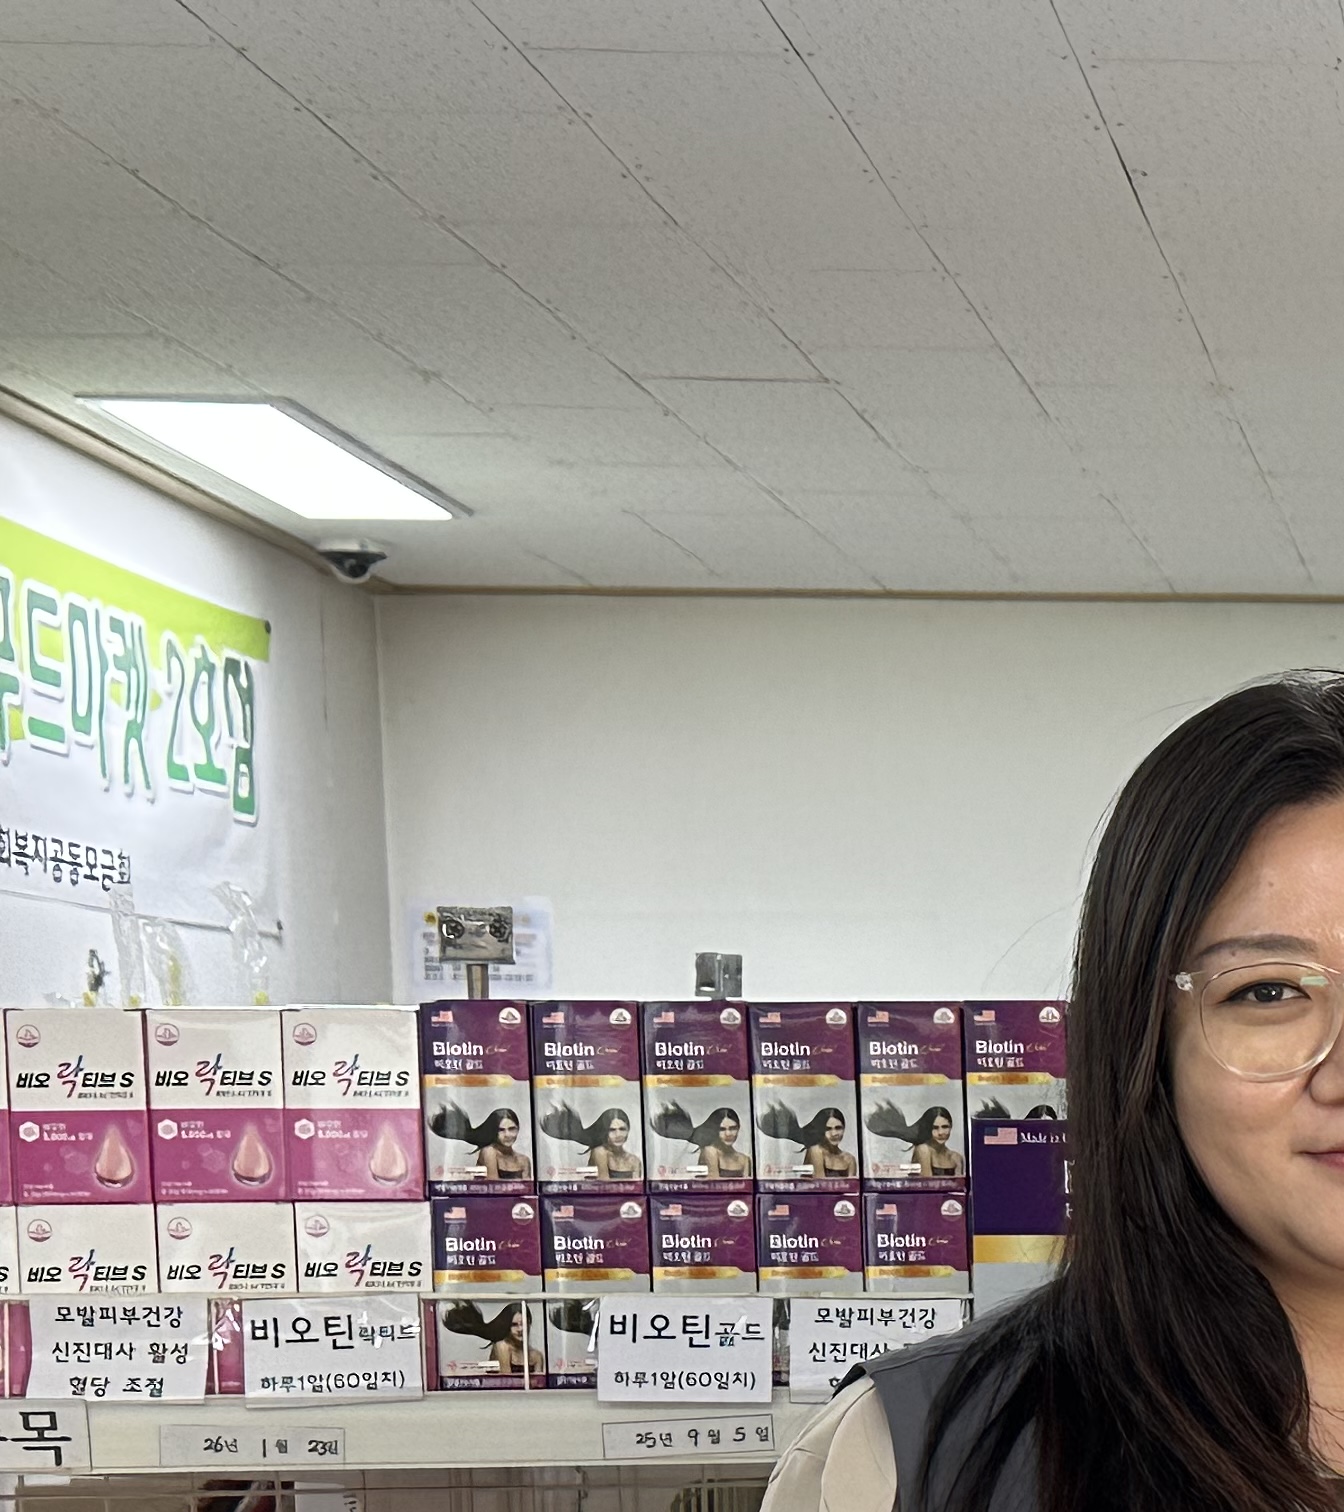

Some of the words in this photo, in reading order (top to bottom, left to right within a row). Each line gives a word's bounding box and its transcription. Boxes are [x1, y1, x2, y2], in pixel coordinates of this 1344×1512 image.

[655, 1042, 705, 1056] Biotin
[869, 1041, 919, 1055] Biotin
[975, 1040, 1025, 1053] Biotin
[814, 1307, 937, 1329] 모발피부건강
[52, 1343, 136, 1364] 신진대사
